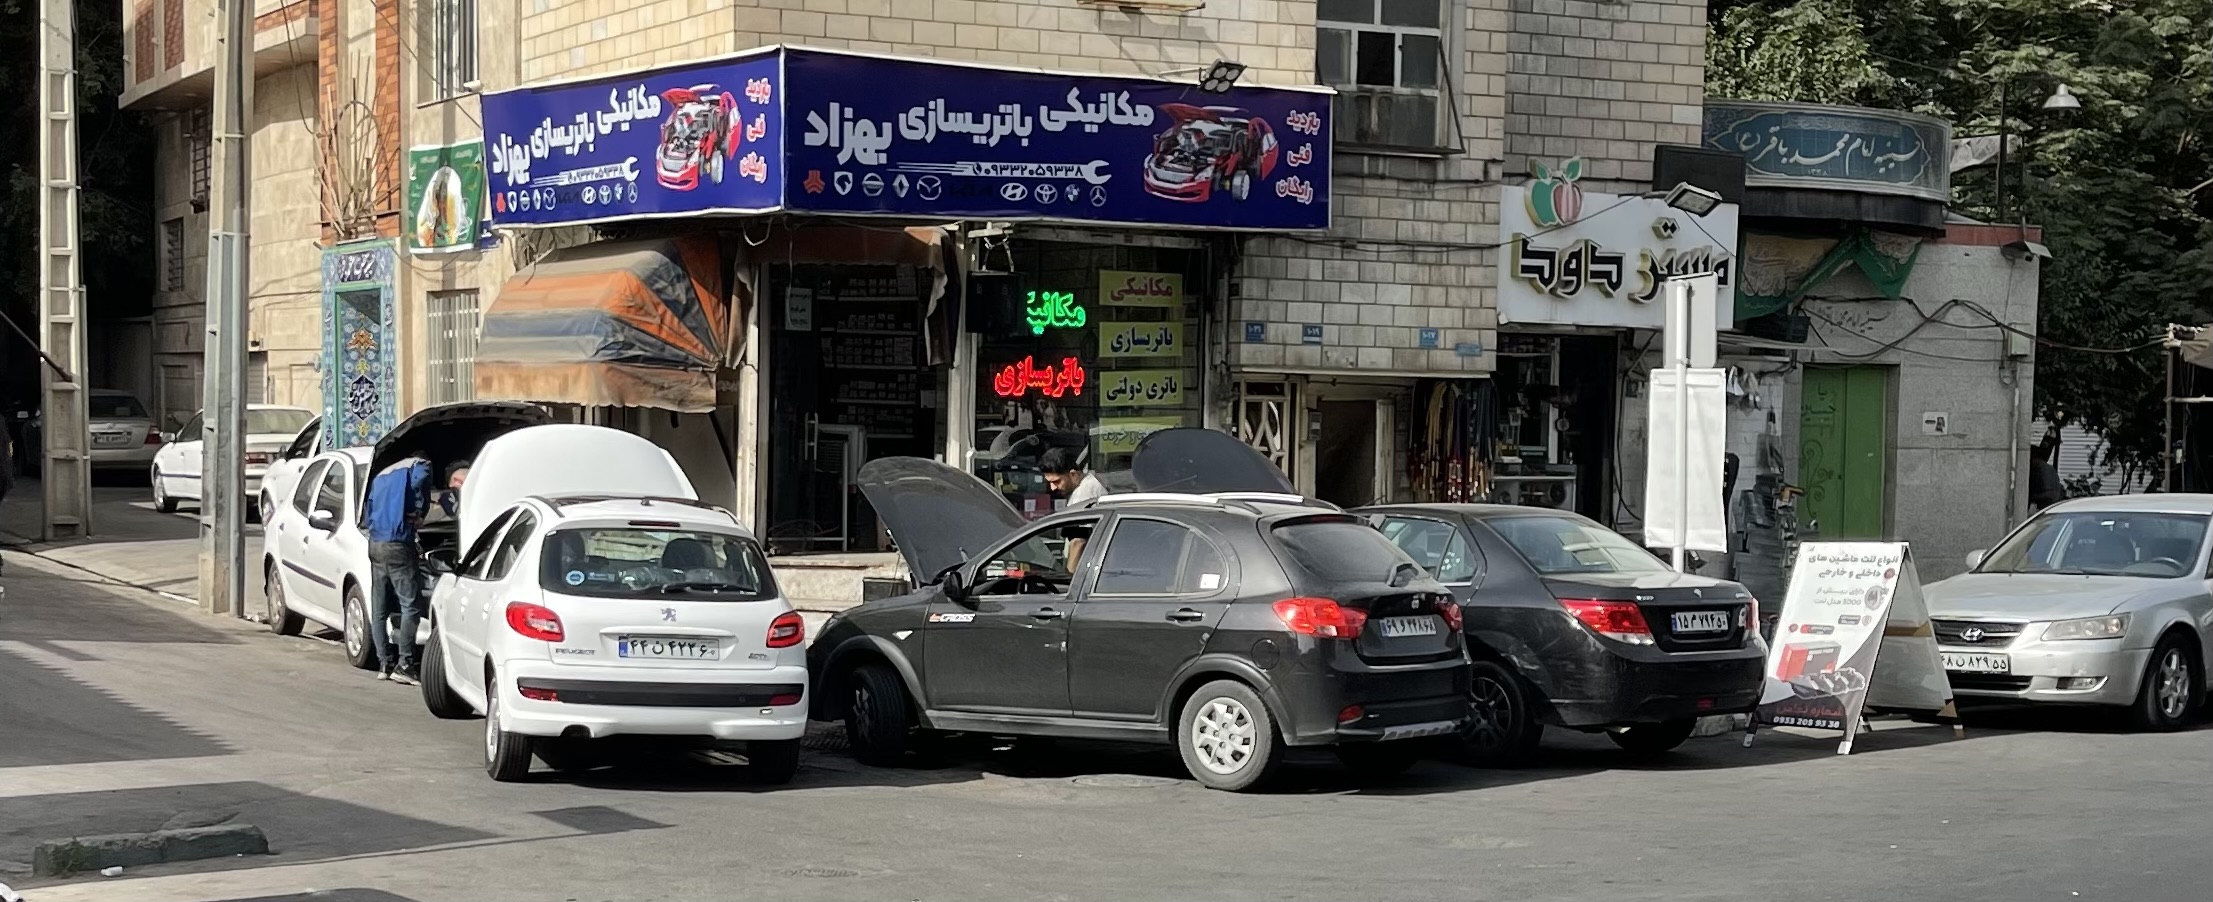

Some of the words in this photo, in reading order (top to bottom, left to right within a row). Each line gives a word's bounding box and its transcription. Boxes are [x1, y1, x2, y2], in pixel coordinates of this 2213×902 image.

[596, 84, 662, 135] مکانیکی
[1039, 87, 1154, 134] مکانیکی
[1286, 108, 1320, 136] بازدید
[530, 111, 596, 159] باتریسازی
[804, 102, 893, 165] بهزاد
[899, 98, 1034, 147] باتریسازی
[1286, 141, 1312, 166] فنی
[1753, 125, 1788, 164] باقر
[1789, 133, 1851, 166] محمد
[1845, 136, 1876, 176] امام
[492, 132, 531, 187] بهزاد
[984, 164, 1083, 176] ۰۹۳۳۲۰۵۹۳۳۸
[1275, 176, 1314, 204] رایگان
[1110, 276, 1173, 302] مکانیکی
[1026, 291, 1087, 336] مکانی
[1110, 326, 1173, 353] باتریسازی
[994, 355, 1086, 397] باتریسازی
[1146, 376, 1177, 400] باتری
[1107, 378, 1142, 401] دولتی
[1809, 554, 1827, 563] های
[1829, 554, 1859, 565] ماشین
[1861, 555, 1876, 563] لنت
[1877, 555, 1899, 567] انواع
[1819, 567, 1847, 578] خارجی
[1848, 570, 1854, 578] و
[1855, 568, 1881, 579] داخلی
[1678, 614, 1689, 629] ۱۵
[630, 639, 648, 655] ۴۴
[652, 640, 664, 654] ن
[1968, 656, 1990, 668] ۸۲۹
[1992, 659, 2007, 669] ۵۵
[1773, 716, 1795, 725] 0933
[1808, 706, 1844, 717] شماره
